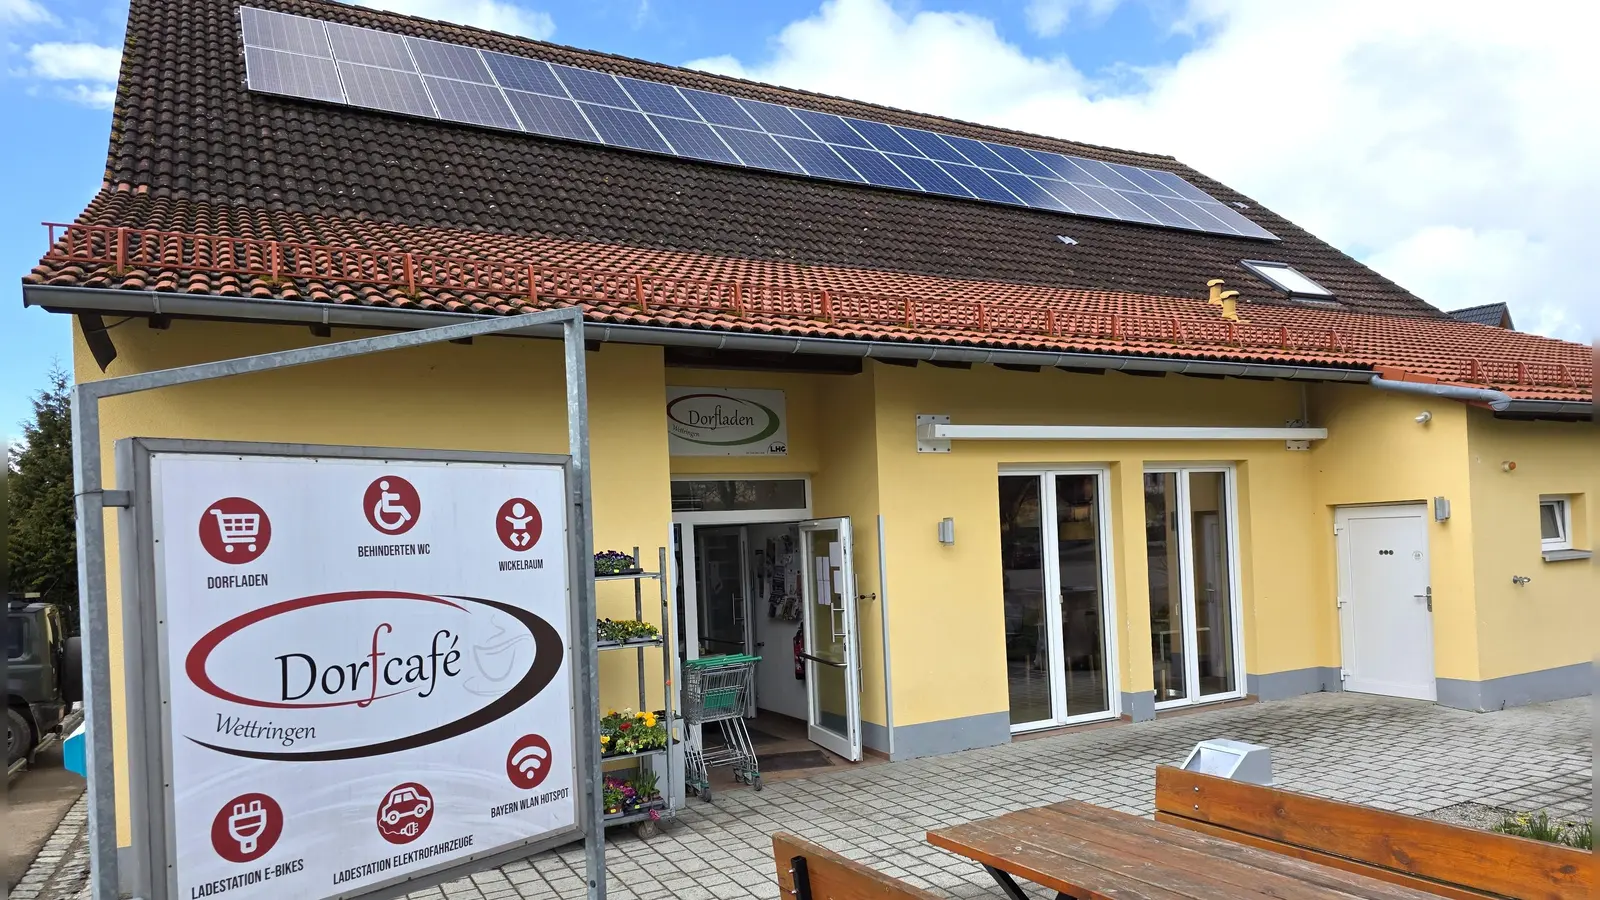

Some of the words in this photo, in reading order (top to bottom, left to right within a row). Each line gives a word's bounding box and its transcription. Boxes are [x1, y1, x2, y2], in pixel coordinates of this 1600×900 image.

[689, 405, 754, 430] Dorfladen
[357, 545, 416, 558] BEHINDERTEN
[417, 543, 431, 555] WC
[498, 558, 544, 572] WICKELRAUM
[207, 573, 269, 590] DORFLADEN
[275, 623, 461, 708] Dorfcafé
[216, 713, 317, 747] Wettringen
[491, 801, 518, 818] BAYERN
[520, 796, 539, 810] WLAN
[540, 787, 569, 804] HOTSPOT
[333, 858, 391, 885] LADESTATION
[393, 834, 474, 867] ELEKTROFAHRZEUGE
[191, 869, 262, 900] LADESTATION
[264, 858, 304, 880] E-BIKES
